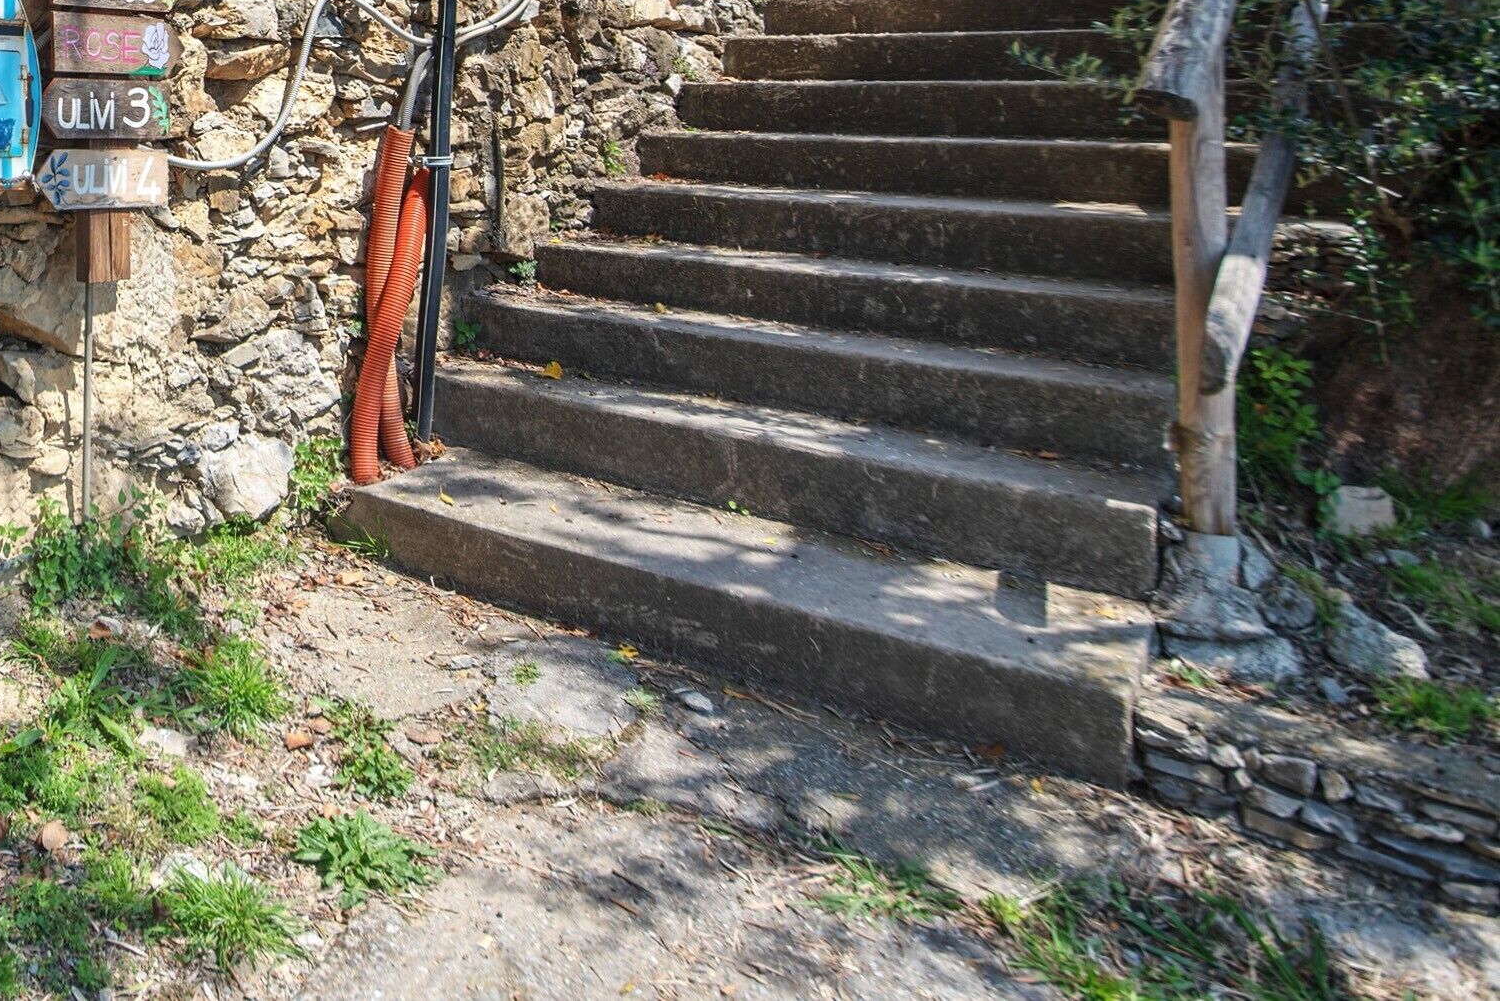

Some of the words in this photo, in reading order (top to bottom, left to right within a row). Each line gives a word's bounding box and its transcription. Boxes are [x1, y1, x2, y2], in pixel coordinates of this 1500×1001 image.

[63, 25, 142, 64] ROSE
[122, 87, 150, 129] 3
[135, 156, 162, 202] 4
